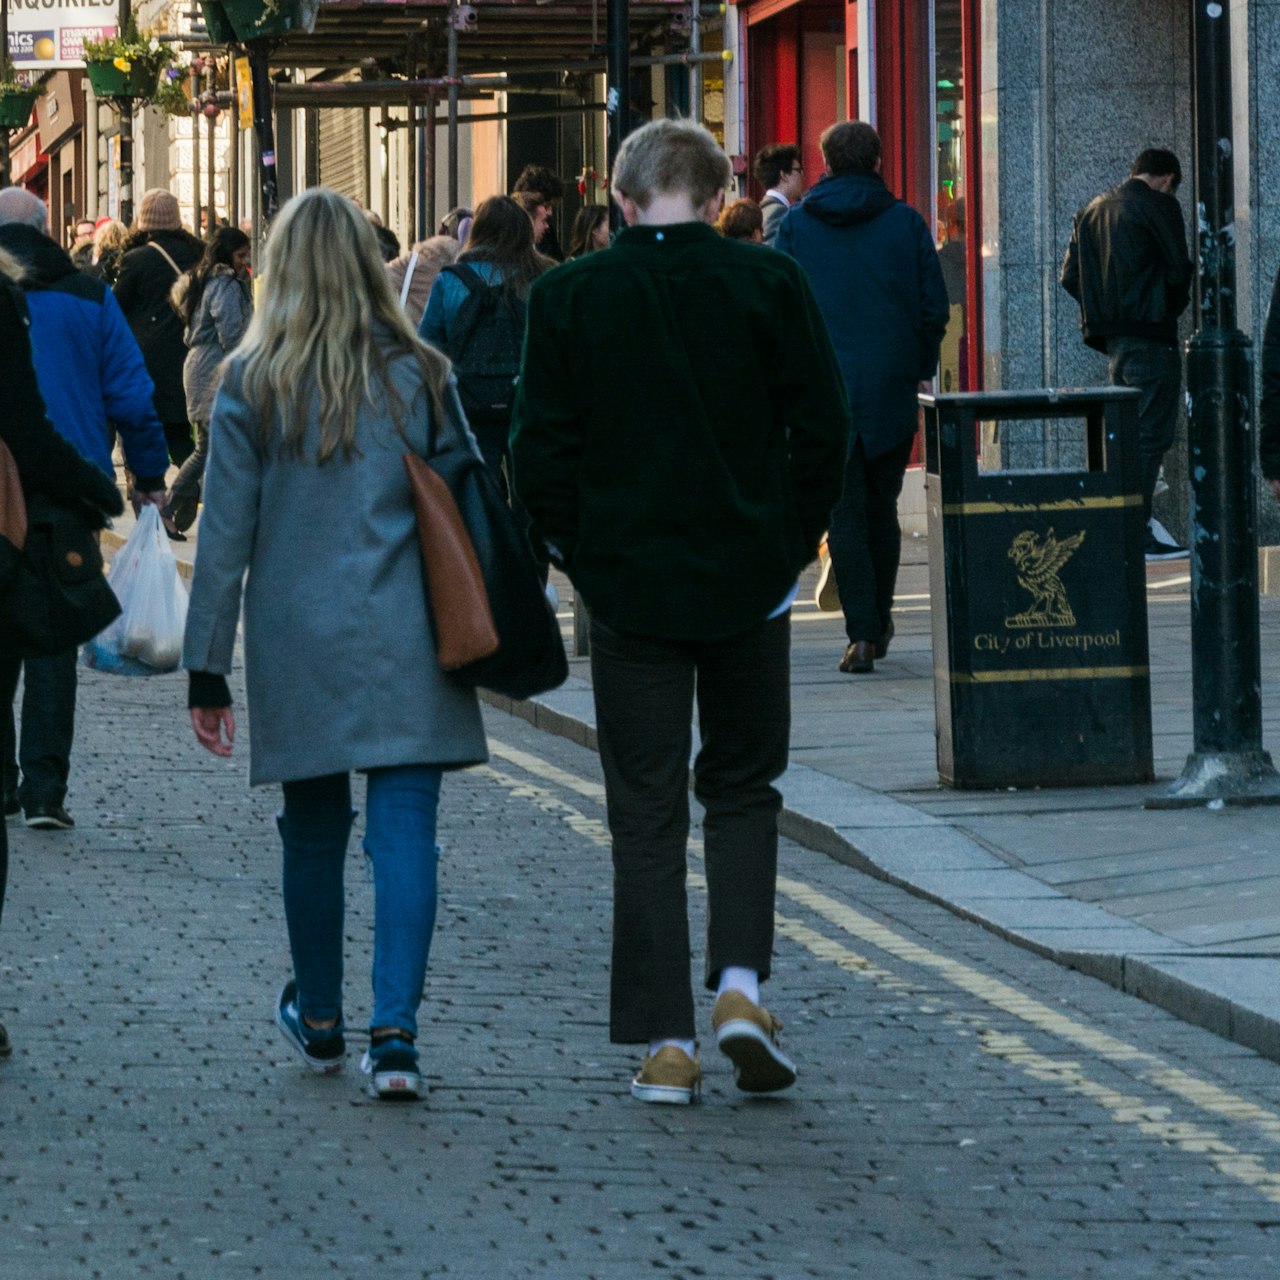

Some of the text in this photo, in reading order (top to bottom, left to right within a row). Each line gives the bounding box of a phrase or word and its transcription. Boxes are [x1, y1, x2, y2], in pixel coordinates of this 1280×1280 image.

[973, 627, 1122, 655] City of Liverpool
